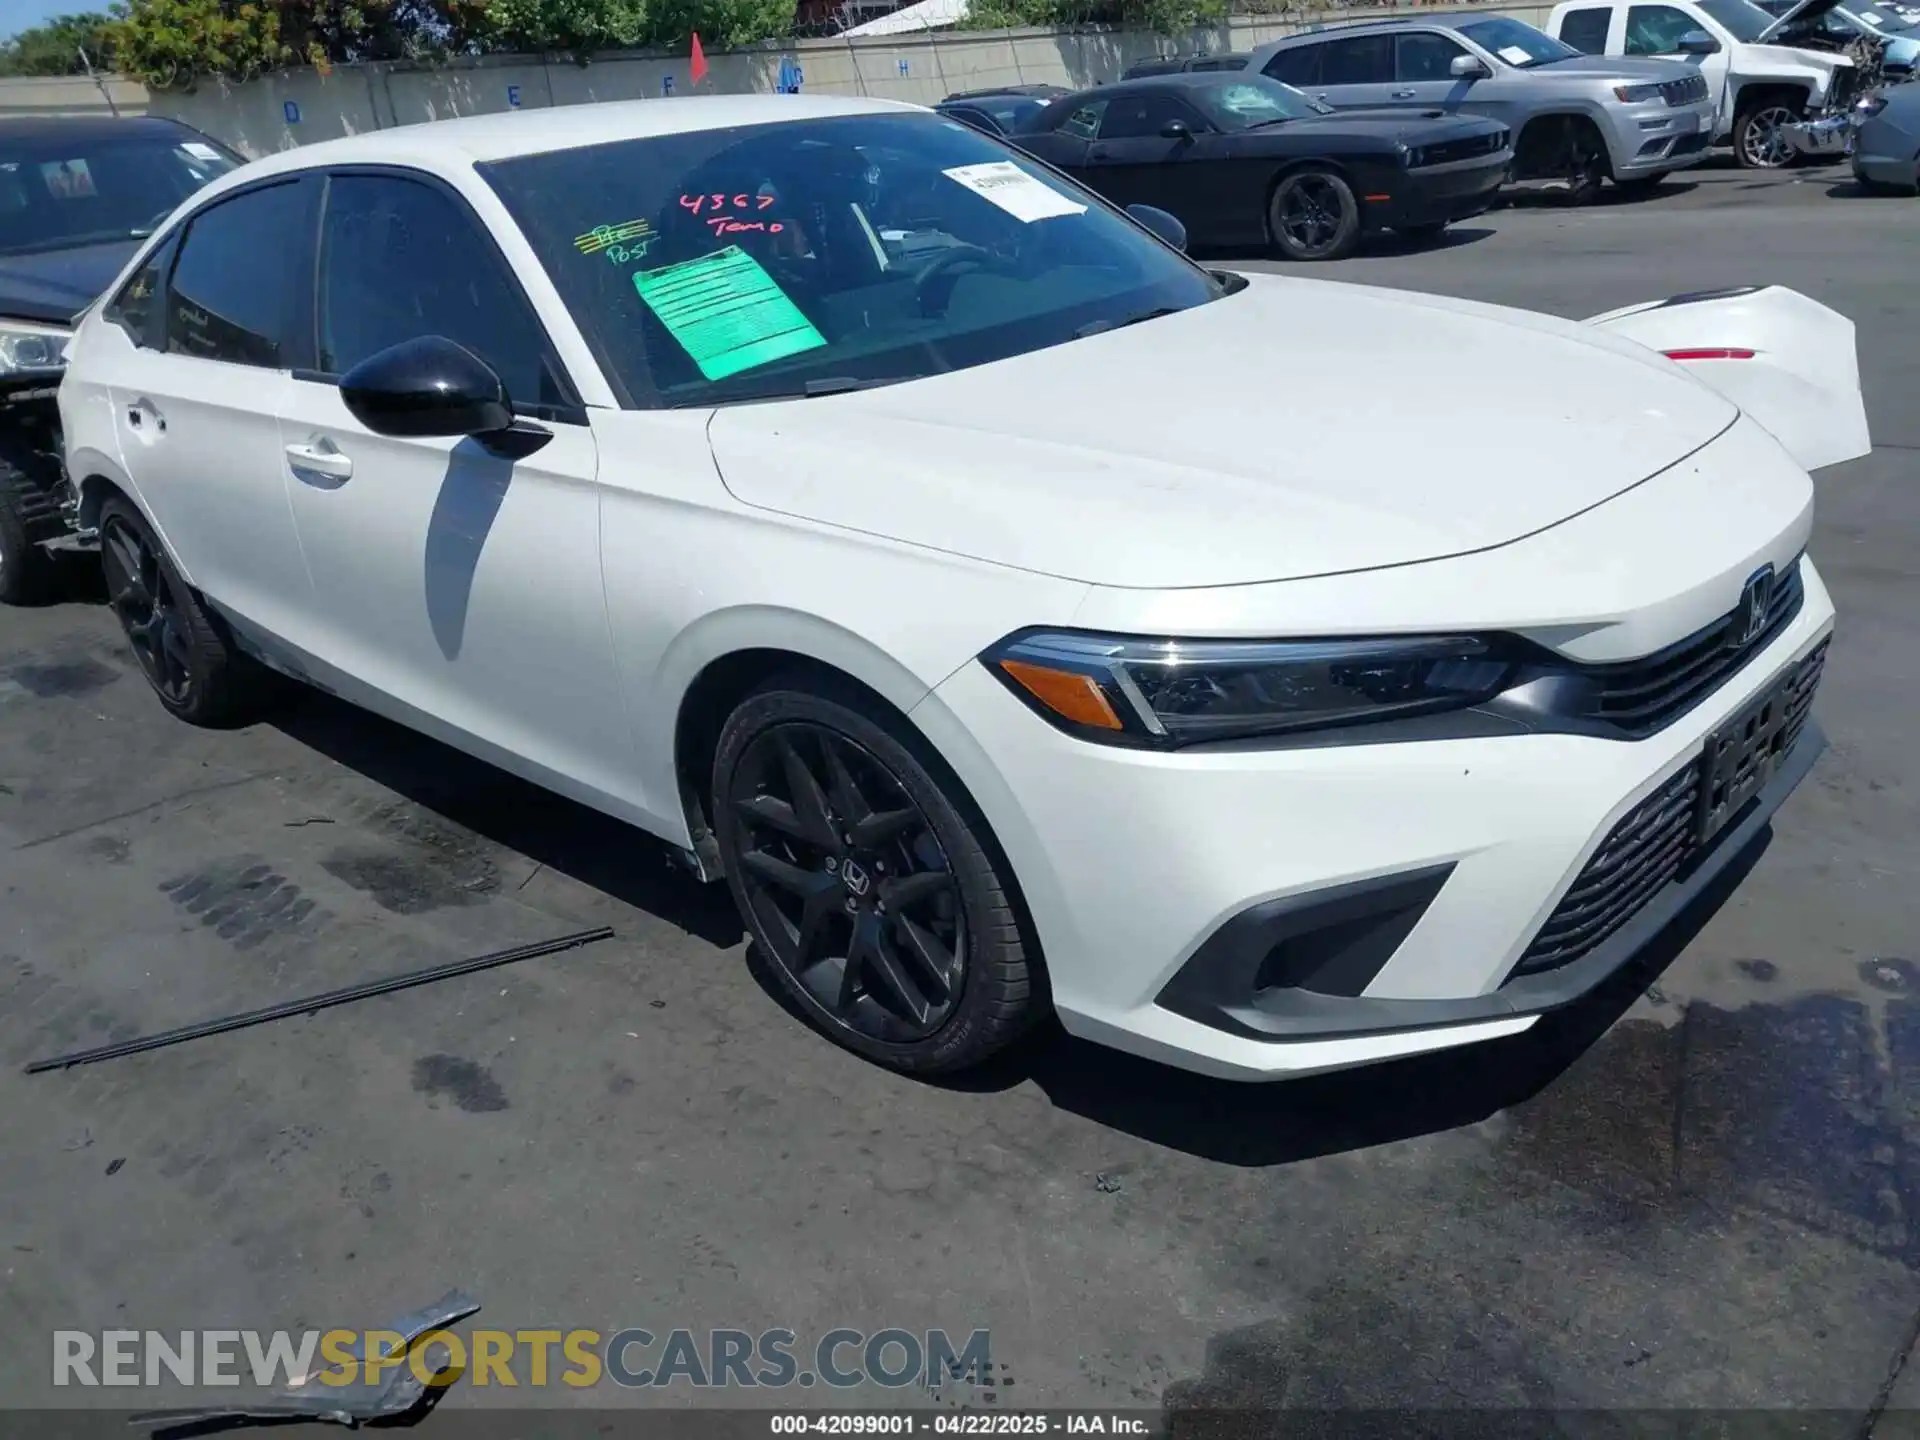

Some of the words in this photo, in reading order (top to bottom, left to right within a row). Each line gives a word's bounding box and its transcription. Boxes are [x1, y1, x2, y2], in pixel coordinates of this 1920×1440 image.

[899, 60, 908, 76] H
[508, 86, 520, 106] E
[664, 77, 674, 97] F
[284, 101, 299, 124] D
[679, 194, 775, 215] 4367
